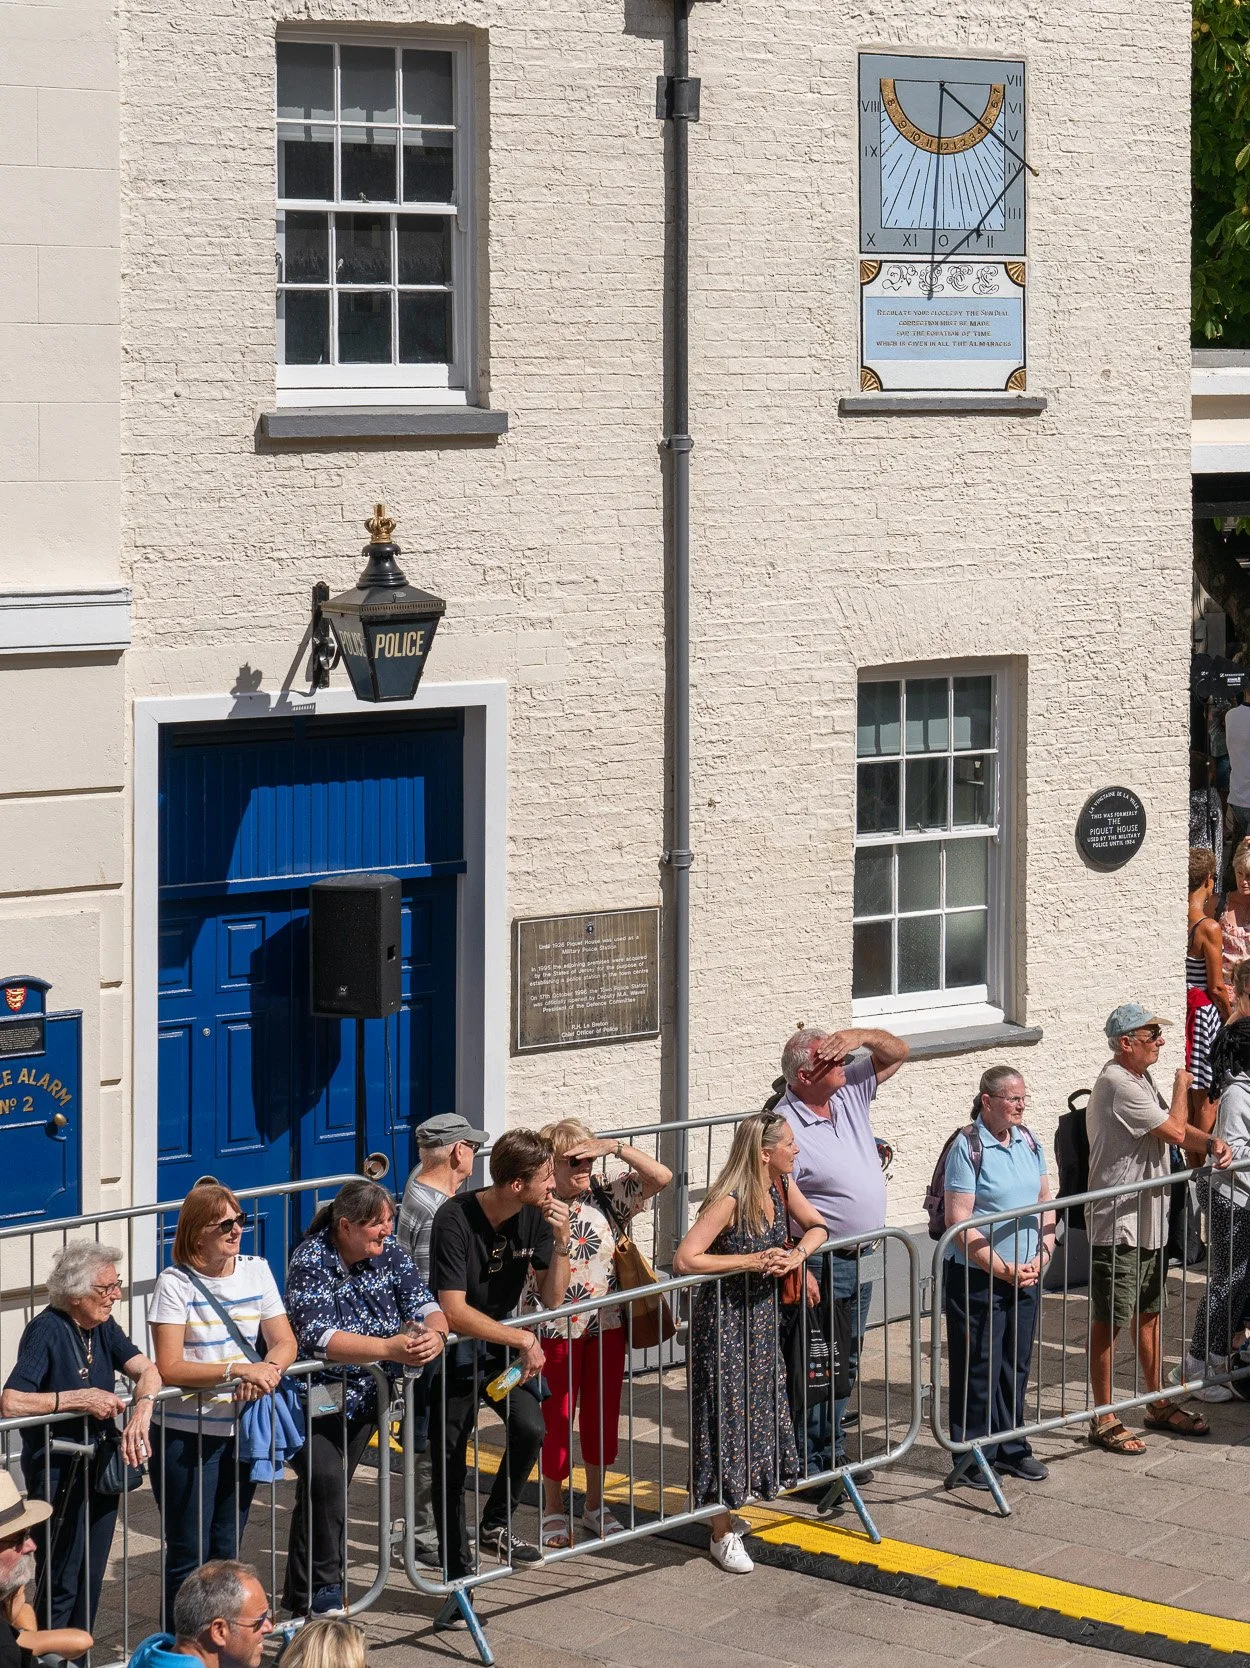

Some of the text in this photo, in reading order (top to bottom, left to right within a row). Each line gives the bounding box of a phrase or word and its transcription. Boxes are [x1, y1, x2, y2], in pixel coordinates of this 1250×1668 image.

[1006, 74, 1022, 87] VII
[862, 100, 880, 113] VIII
[1008, 102, 1022, 114] VI
[898, 120, 907, 129] 9
[911, 131, 921, 142] 10
[940, 142, 949, 150] 12
[960, 139, 968, 148] 2
[969, 133, 977, 143] 3
[977, 127, 984, 135] 4
[985, 116, 992, 124] 5
[1008, 130, 1019, 142] V
[864, 145, 878, 157] IX
[1008, 162, 1022, 174] IV
[1008, 207, 1021, 220] III
[866, 233, 876, 247] X
[902, 234, 917, 247] XI
[987, 235, 994, 248] II
[374, 630, 424, 658] POLICE
[1108, 818, 1120, 826] THE
[1090, 824, 1138, 836] PIQUET HOUSE
[17, 1067, 73, 1107] ALARM
[22, 1096, 34, 1112] 2
